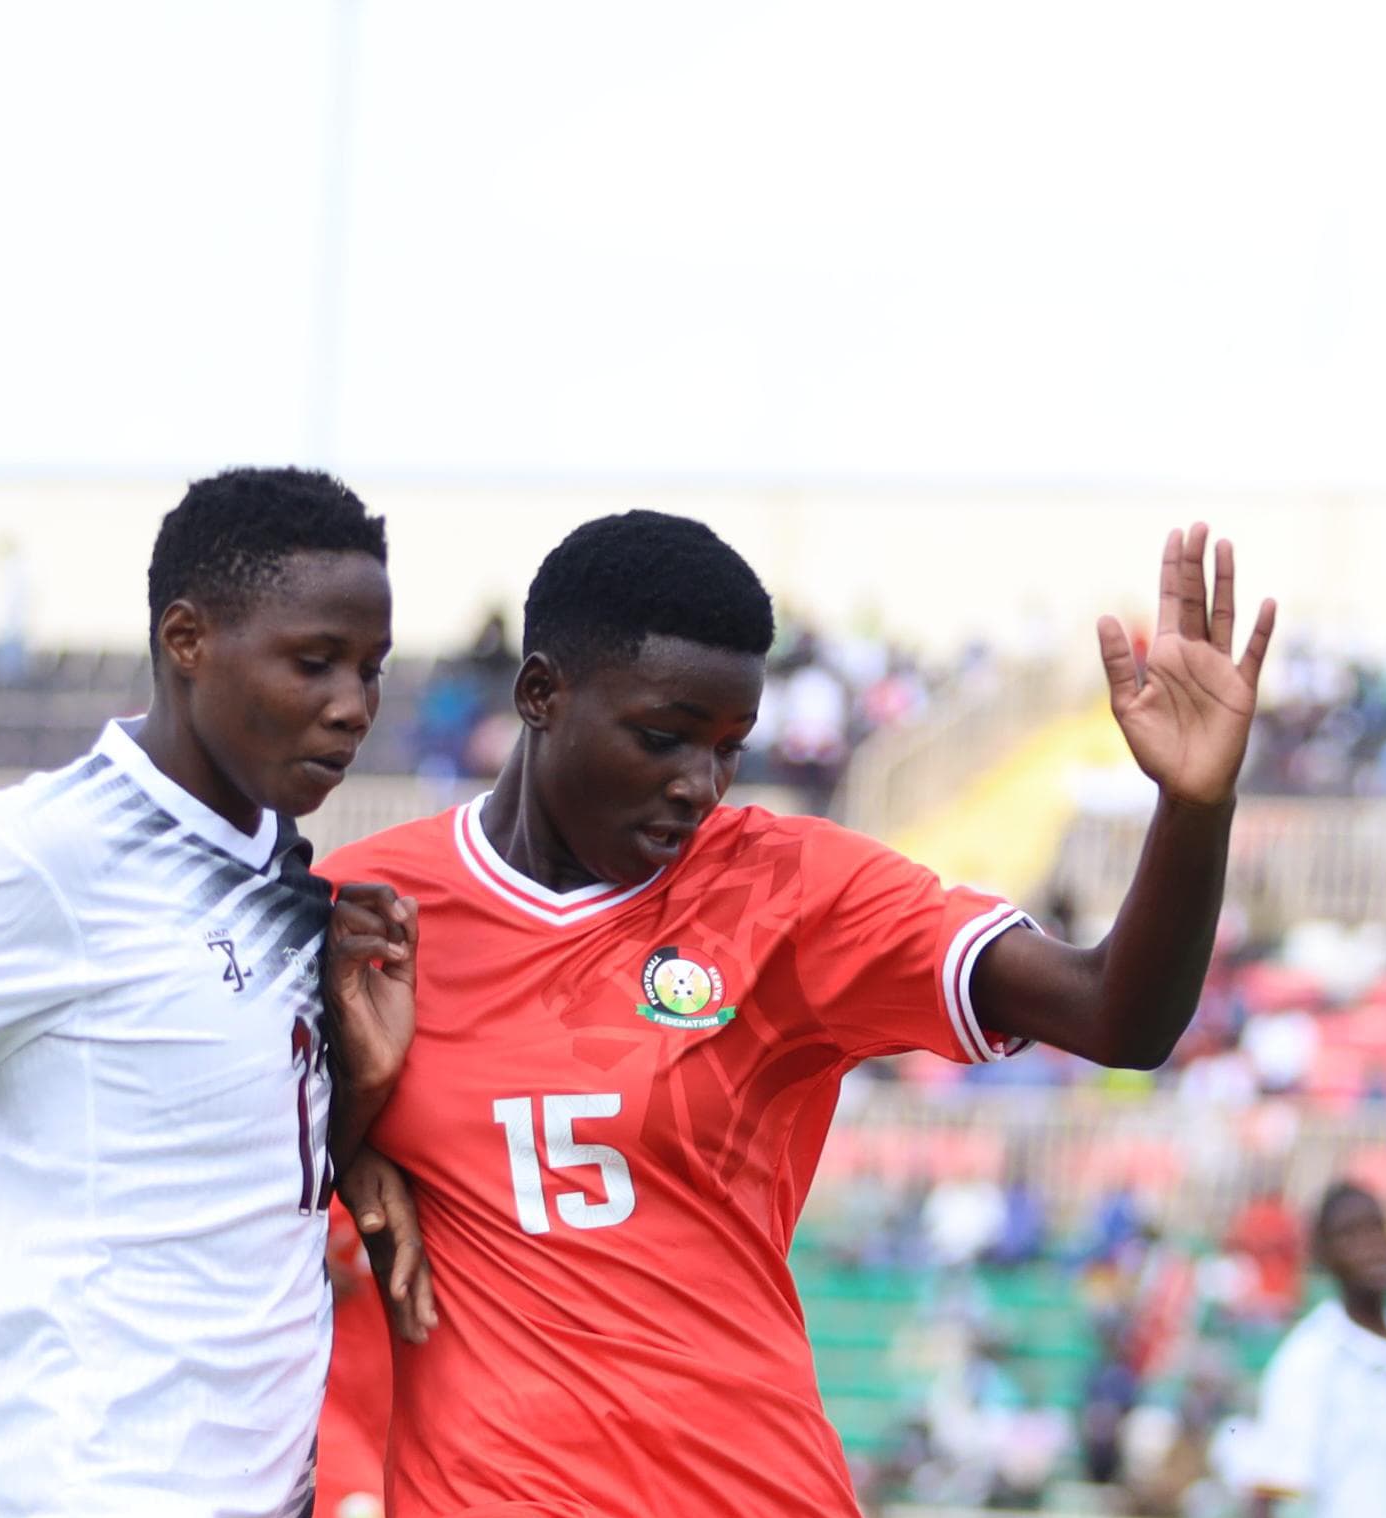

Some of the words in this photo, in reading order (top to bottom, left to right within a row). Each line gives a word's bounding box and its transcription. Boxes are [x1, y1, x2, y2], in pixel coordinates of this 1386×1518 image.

[644, 955, 663, 1006] FOOTBALL
[707, 966, 723, 1001] KENYA
[654, 1013, 719, 1029] FEDERATION
[292, 1015, 335, 1217] 1
[493, 1093, 636, 1235] 15
